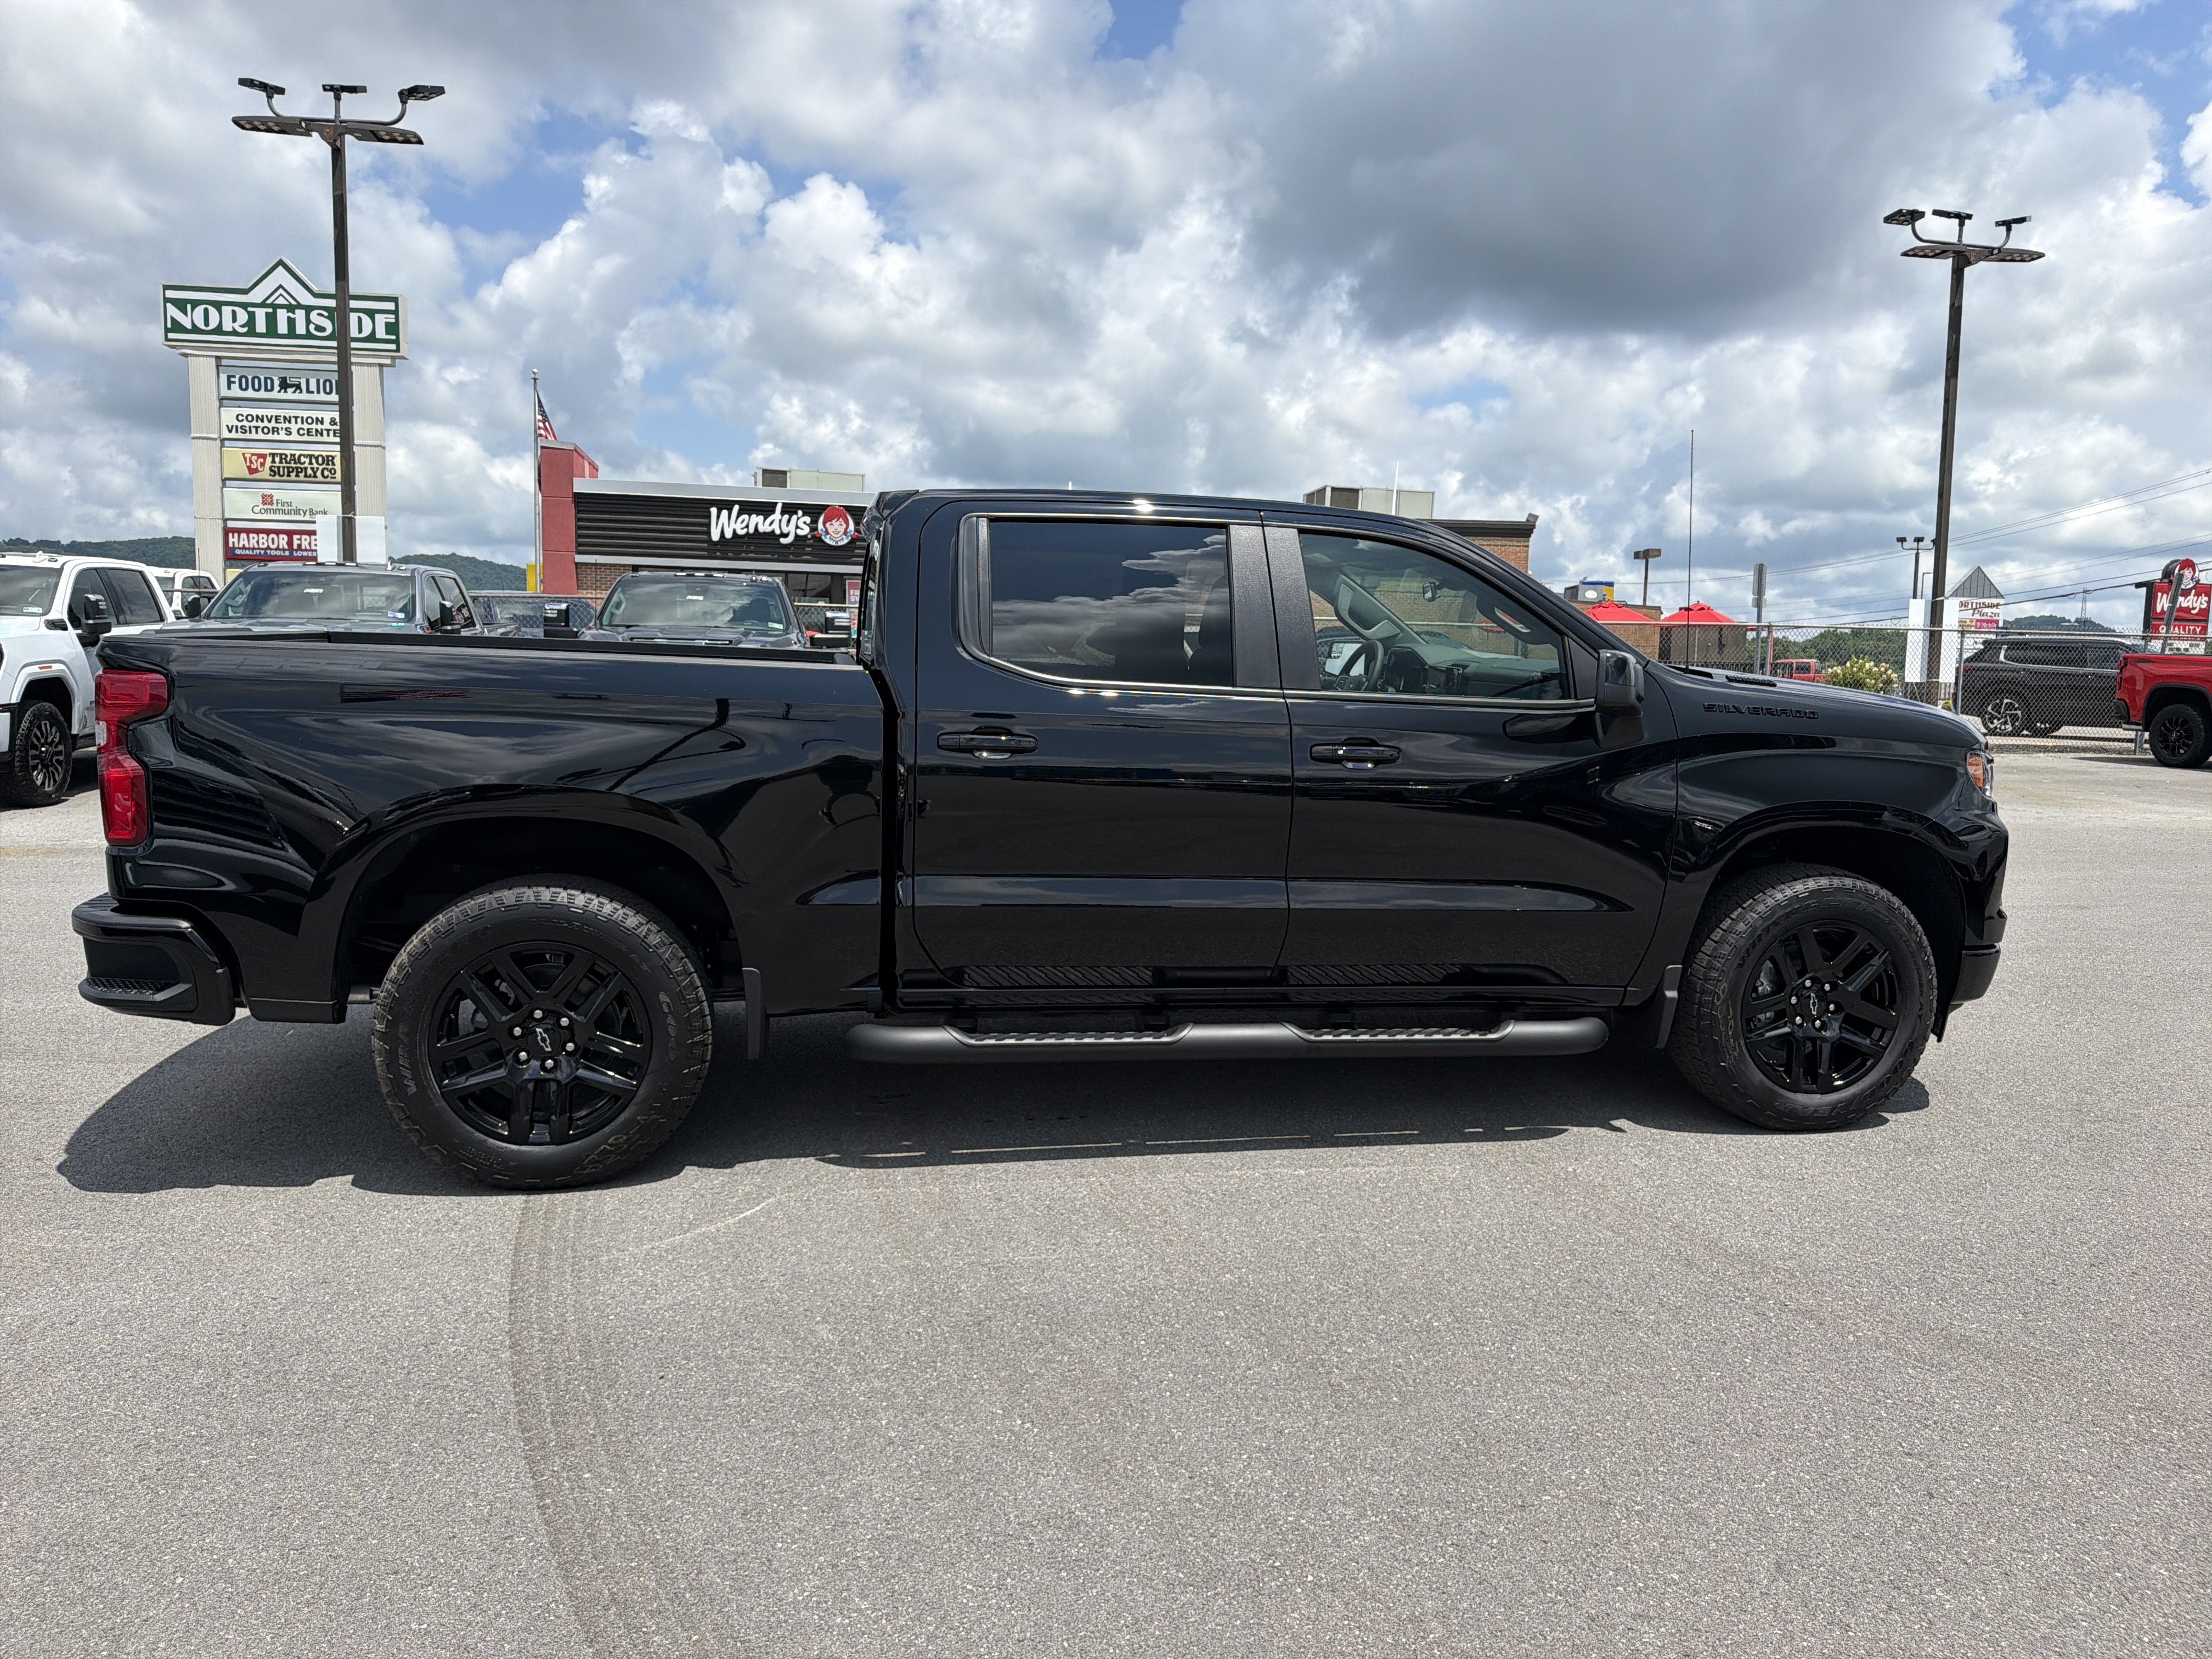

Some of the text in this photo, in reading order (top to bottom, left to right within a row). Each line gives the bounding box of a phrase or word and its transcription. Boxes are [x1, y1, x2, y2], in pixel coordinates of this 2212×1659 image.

[166, 302, 396, 339] NORTHSDE
[227, 375, 274, 392] FOOD
[235, 413, 338, 426] CONVENTION &
[226, 424, 292, 436] VISITOR'S
[244, 454, 264, 471] TSC
[269, 453, 336, 466] TRACTOR
[269, 466, 320, 478] SUPPLY
[276, 499, 293, 507] First
[251, 505, 328, 517] Community Bank
[710, 503, 811, 544] Wendy's
[228, 533, 288, 549] HARBOR
[2157, 590, 2208, 614] Wndy's
[1971, 609, 2000, 618] Plaza
[1703, 703, 1819, 720] SILVERADO
